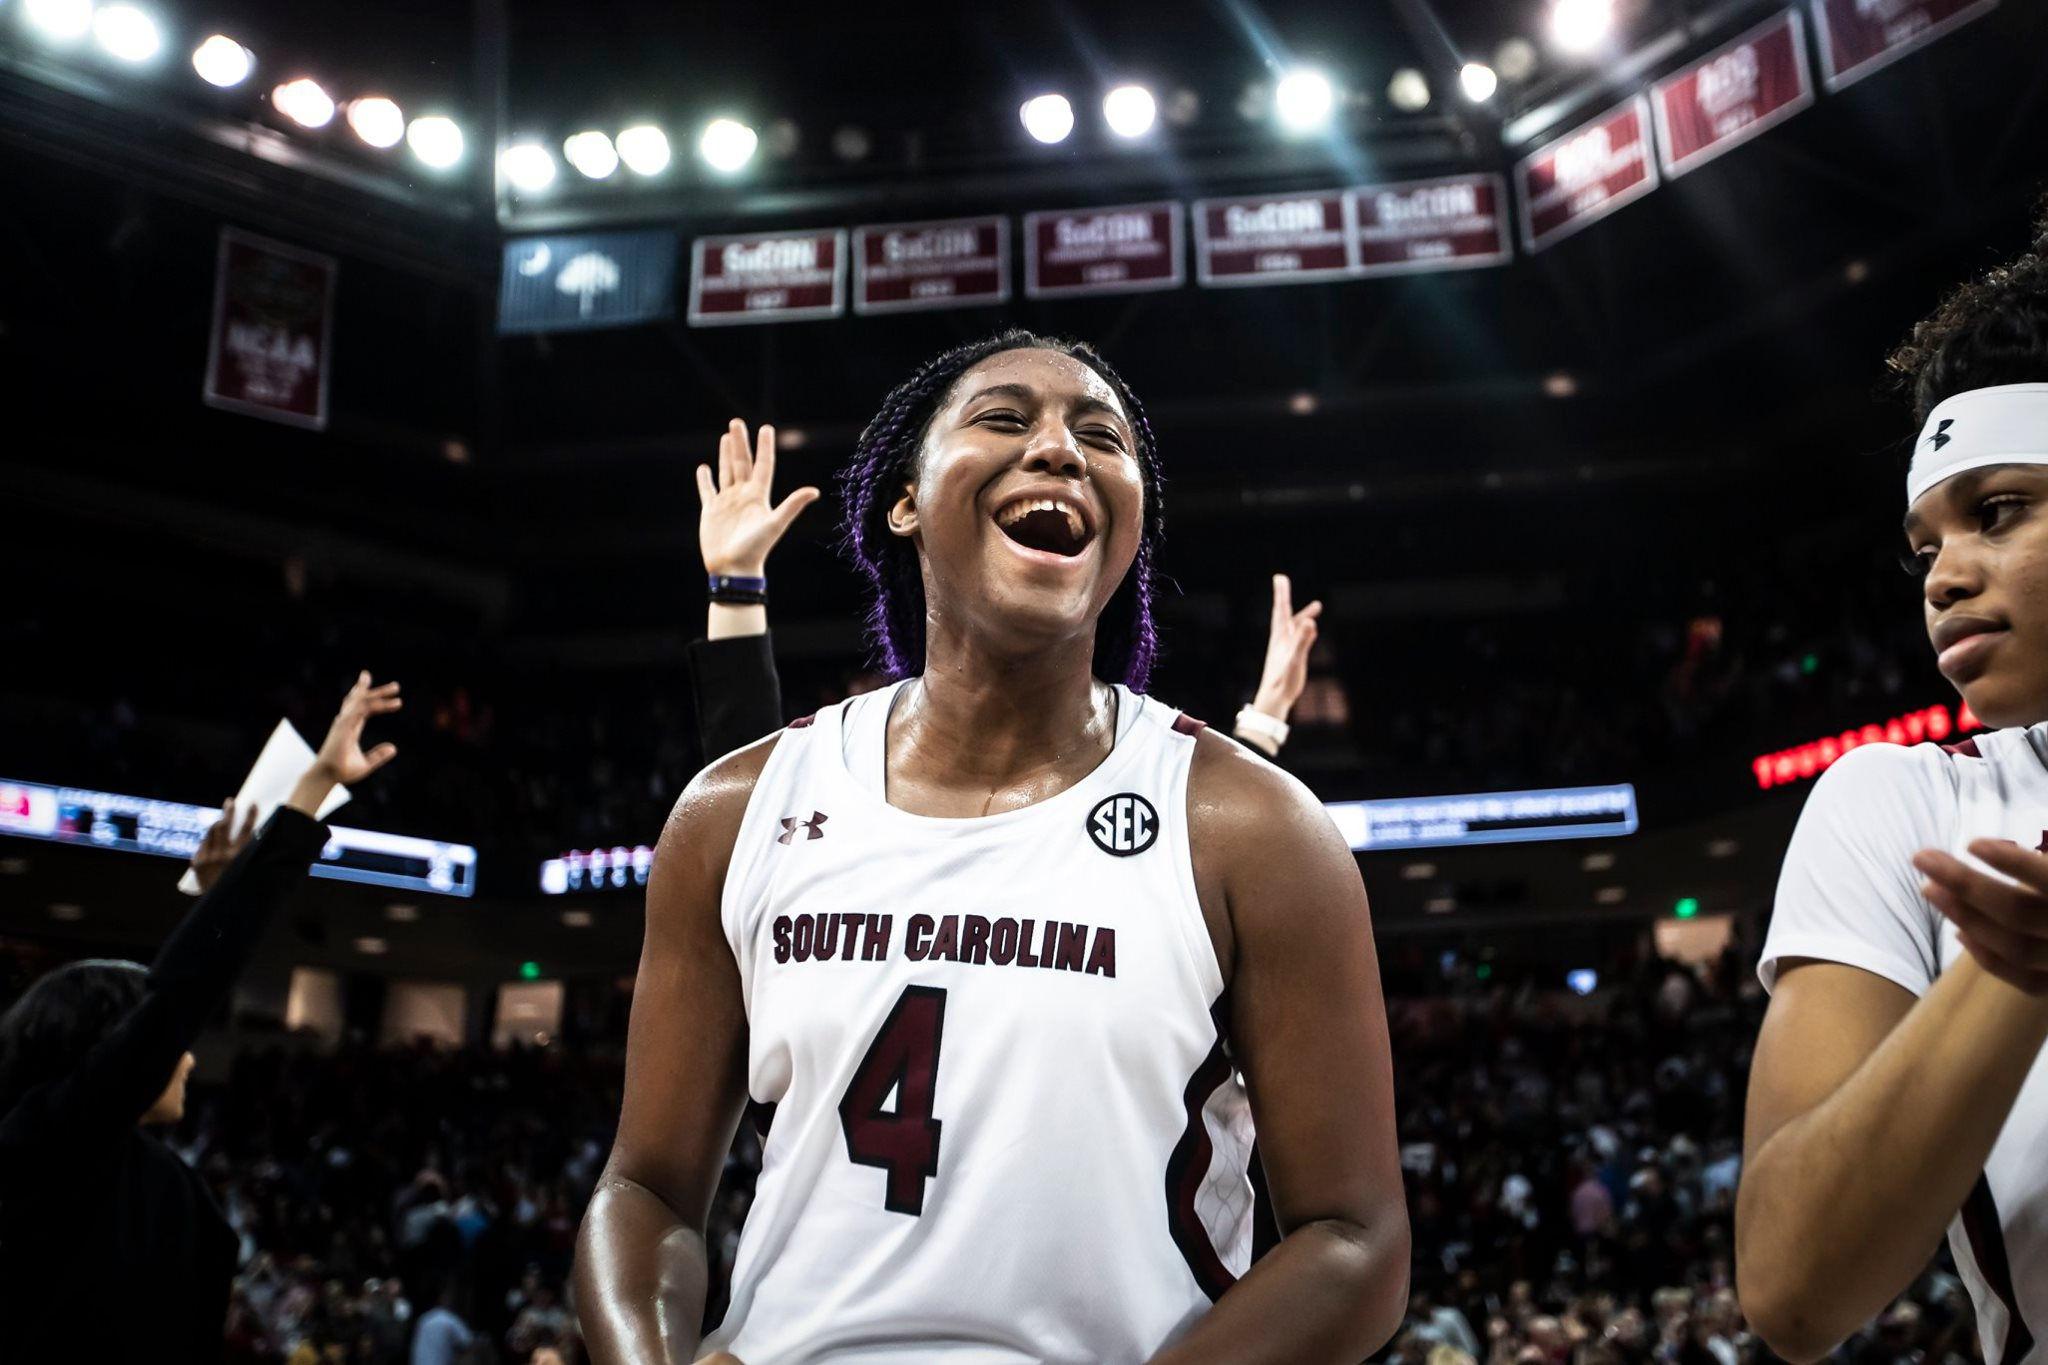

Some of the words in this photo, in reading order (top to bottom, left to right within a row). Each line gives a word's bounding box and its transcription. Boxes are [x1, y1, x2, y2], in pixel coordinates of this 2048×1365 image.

[1093, 797, 1153, 850] SEC
[773, 913, 893, 964] SOUTH
[904, 914, 1116, 978] CAROLINA
[838, 984, 948, 1216] 4
